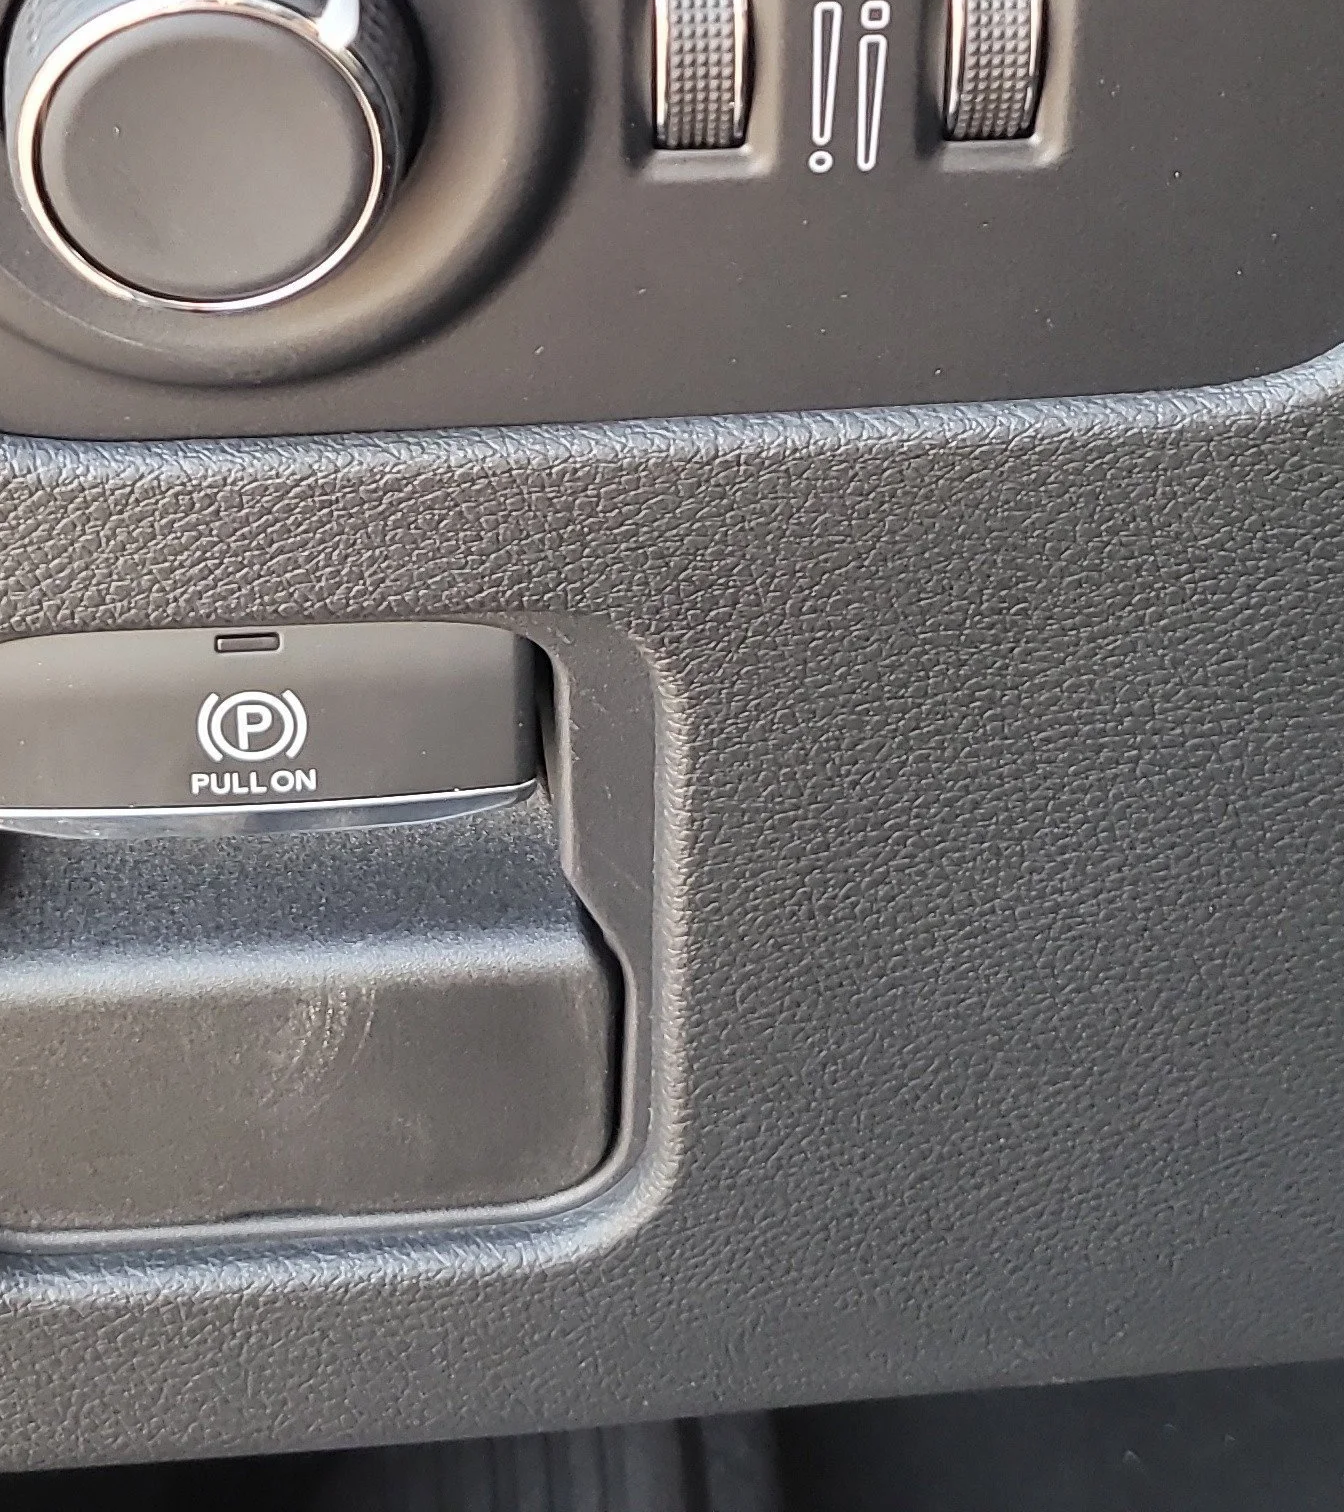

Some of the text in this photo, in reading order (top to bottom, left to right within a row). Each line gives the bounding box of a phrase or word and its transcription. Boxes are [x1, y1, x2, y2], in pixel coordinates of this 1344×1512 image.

[237, 704, 272, 750] P
[190, 768, 317, 795] PULL ON
